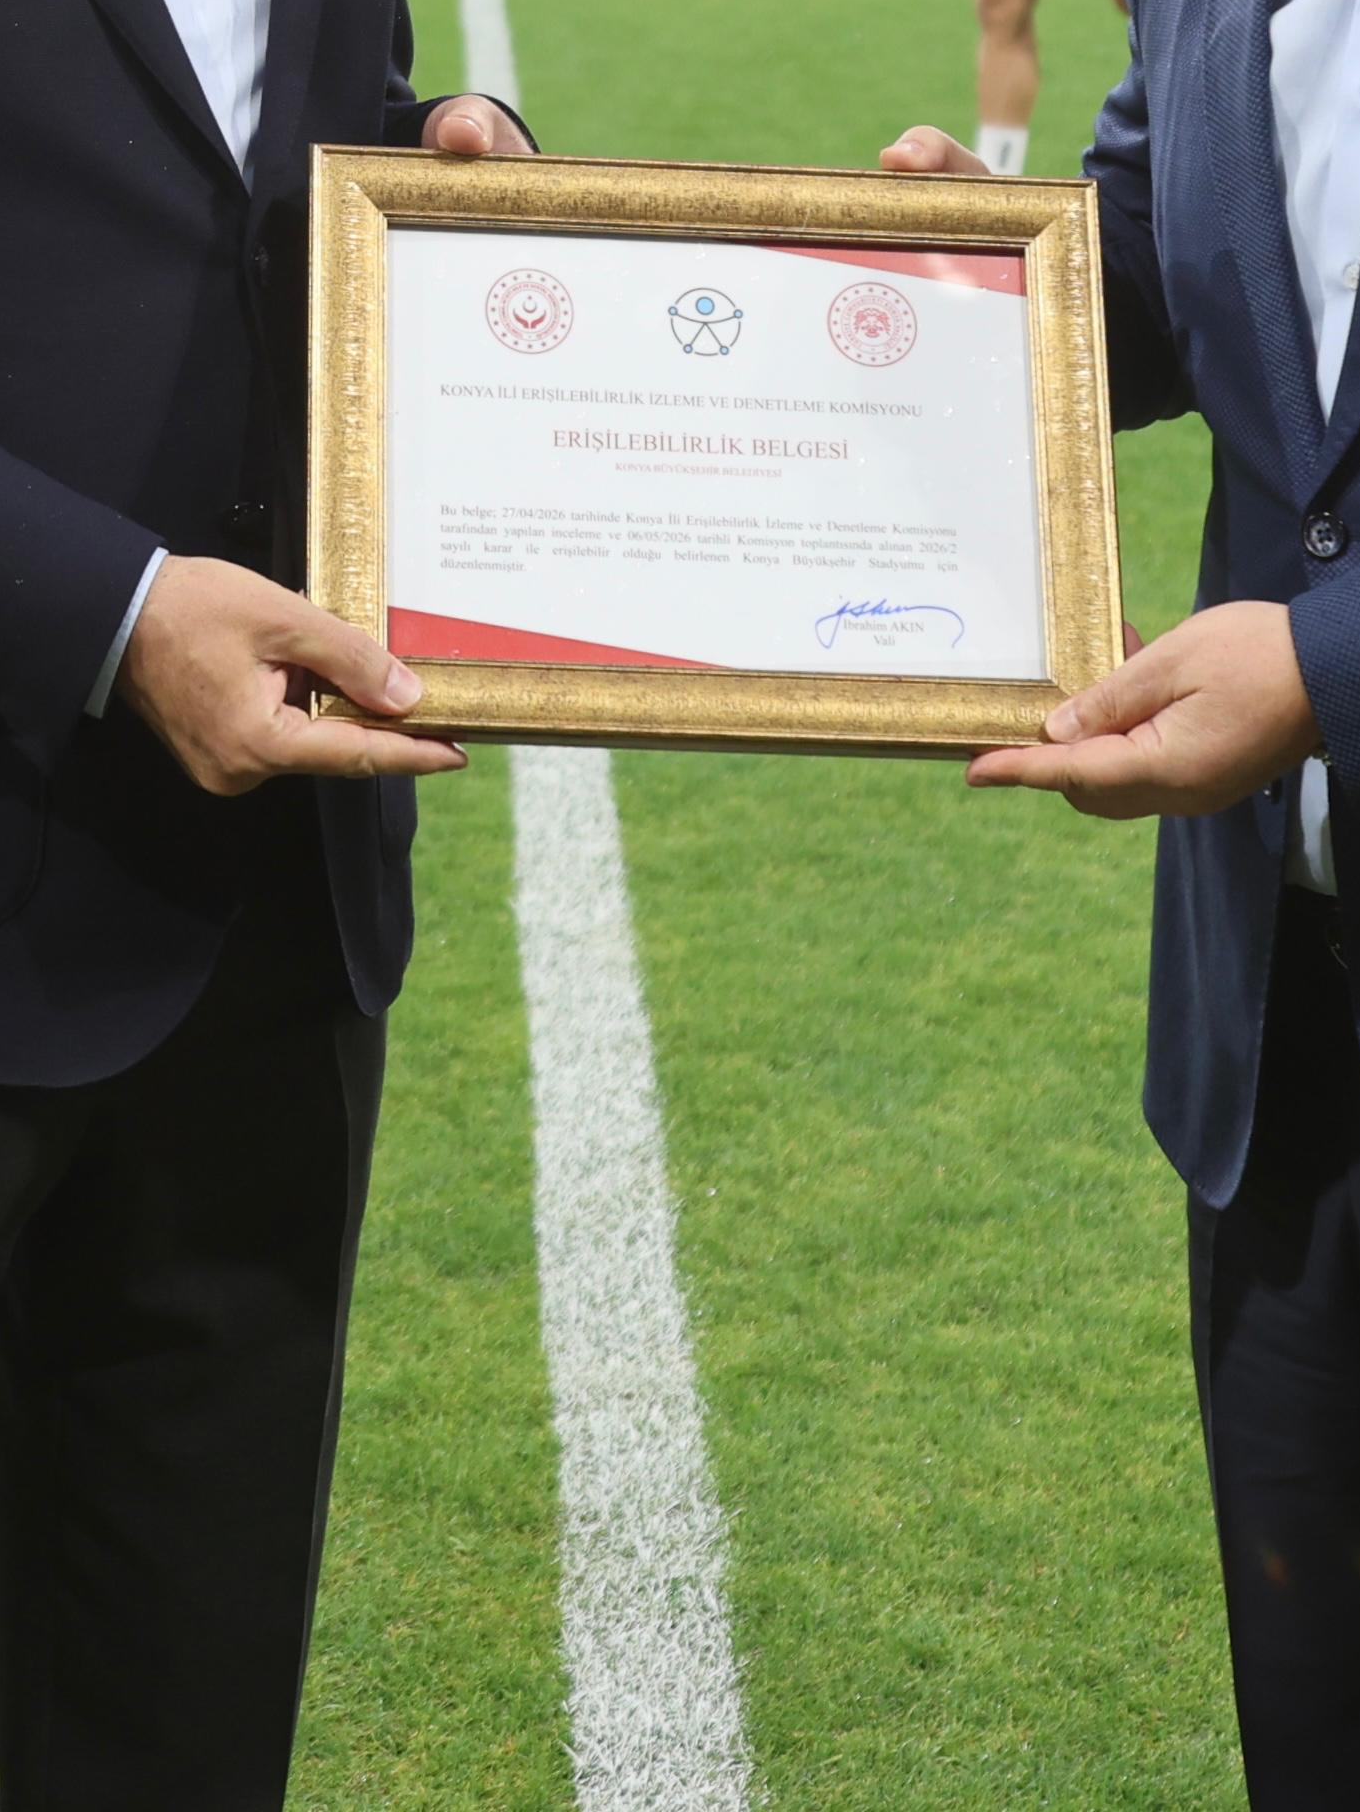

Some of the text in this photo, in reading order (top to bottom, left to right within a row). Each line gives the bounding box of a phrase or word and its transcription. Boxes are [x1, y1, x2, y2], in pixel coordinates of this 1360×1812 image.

[440, 384, 923, 417] KONYA İLİ ERİŞİLEBİLİRLİK İZLEME VE DENETLEME KOMİSYONU
[553, 427, 849, 460] ERİŞİLEBİLİRLİK BELGESİ
[615, 462, 651, 473] KONYA
[440, 505, 457, 516] Bu
[502, 507, 566, 520] 27/04/2026
[571, 511, 621, 523] tarihinde
[625, 514, 663, 527] Konya
[687, 515, 760, 529] Erişilebilirlik
[766, 516, 804, 531] İzleme
[810, 521, 822, 532] ve
[827, 521, 887, 534] Denetleme
[893, 523, 957, 539] Komisyonu
[440, 523, 958, 555] tarafından yapılan inceleme ve 06/05/2026 tarihli Komisyon toplantısında alınan 2026/2
[440, 541, 958, 573] sayılı karar ile erişilebilir olduğu belirlenen Konya Büyükşehir Stadyumu için
[440, 559, 527, 573] düzenlenmiştir.
[873, 634, 896, 646] Vali
[889, 620, 924, 633] AKIN
